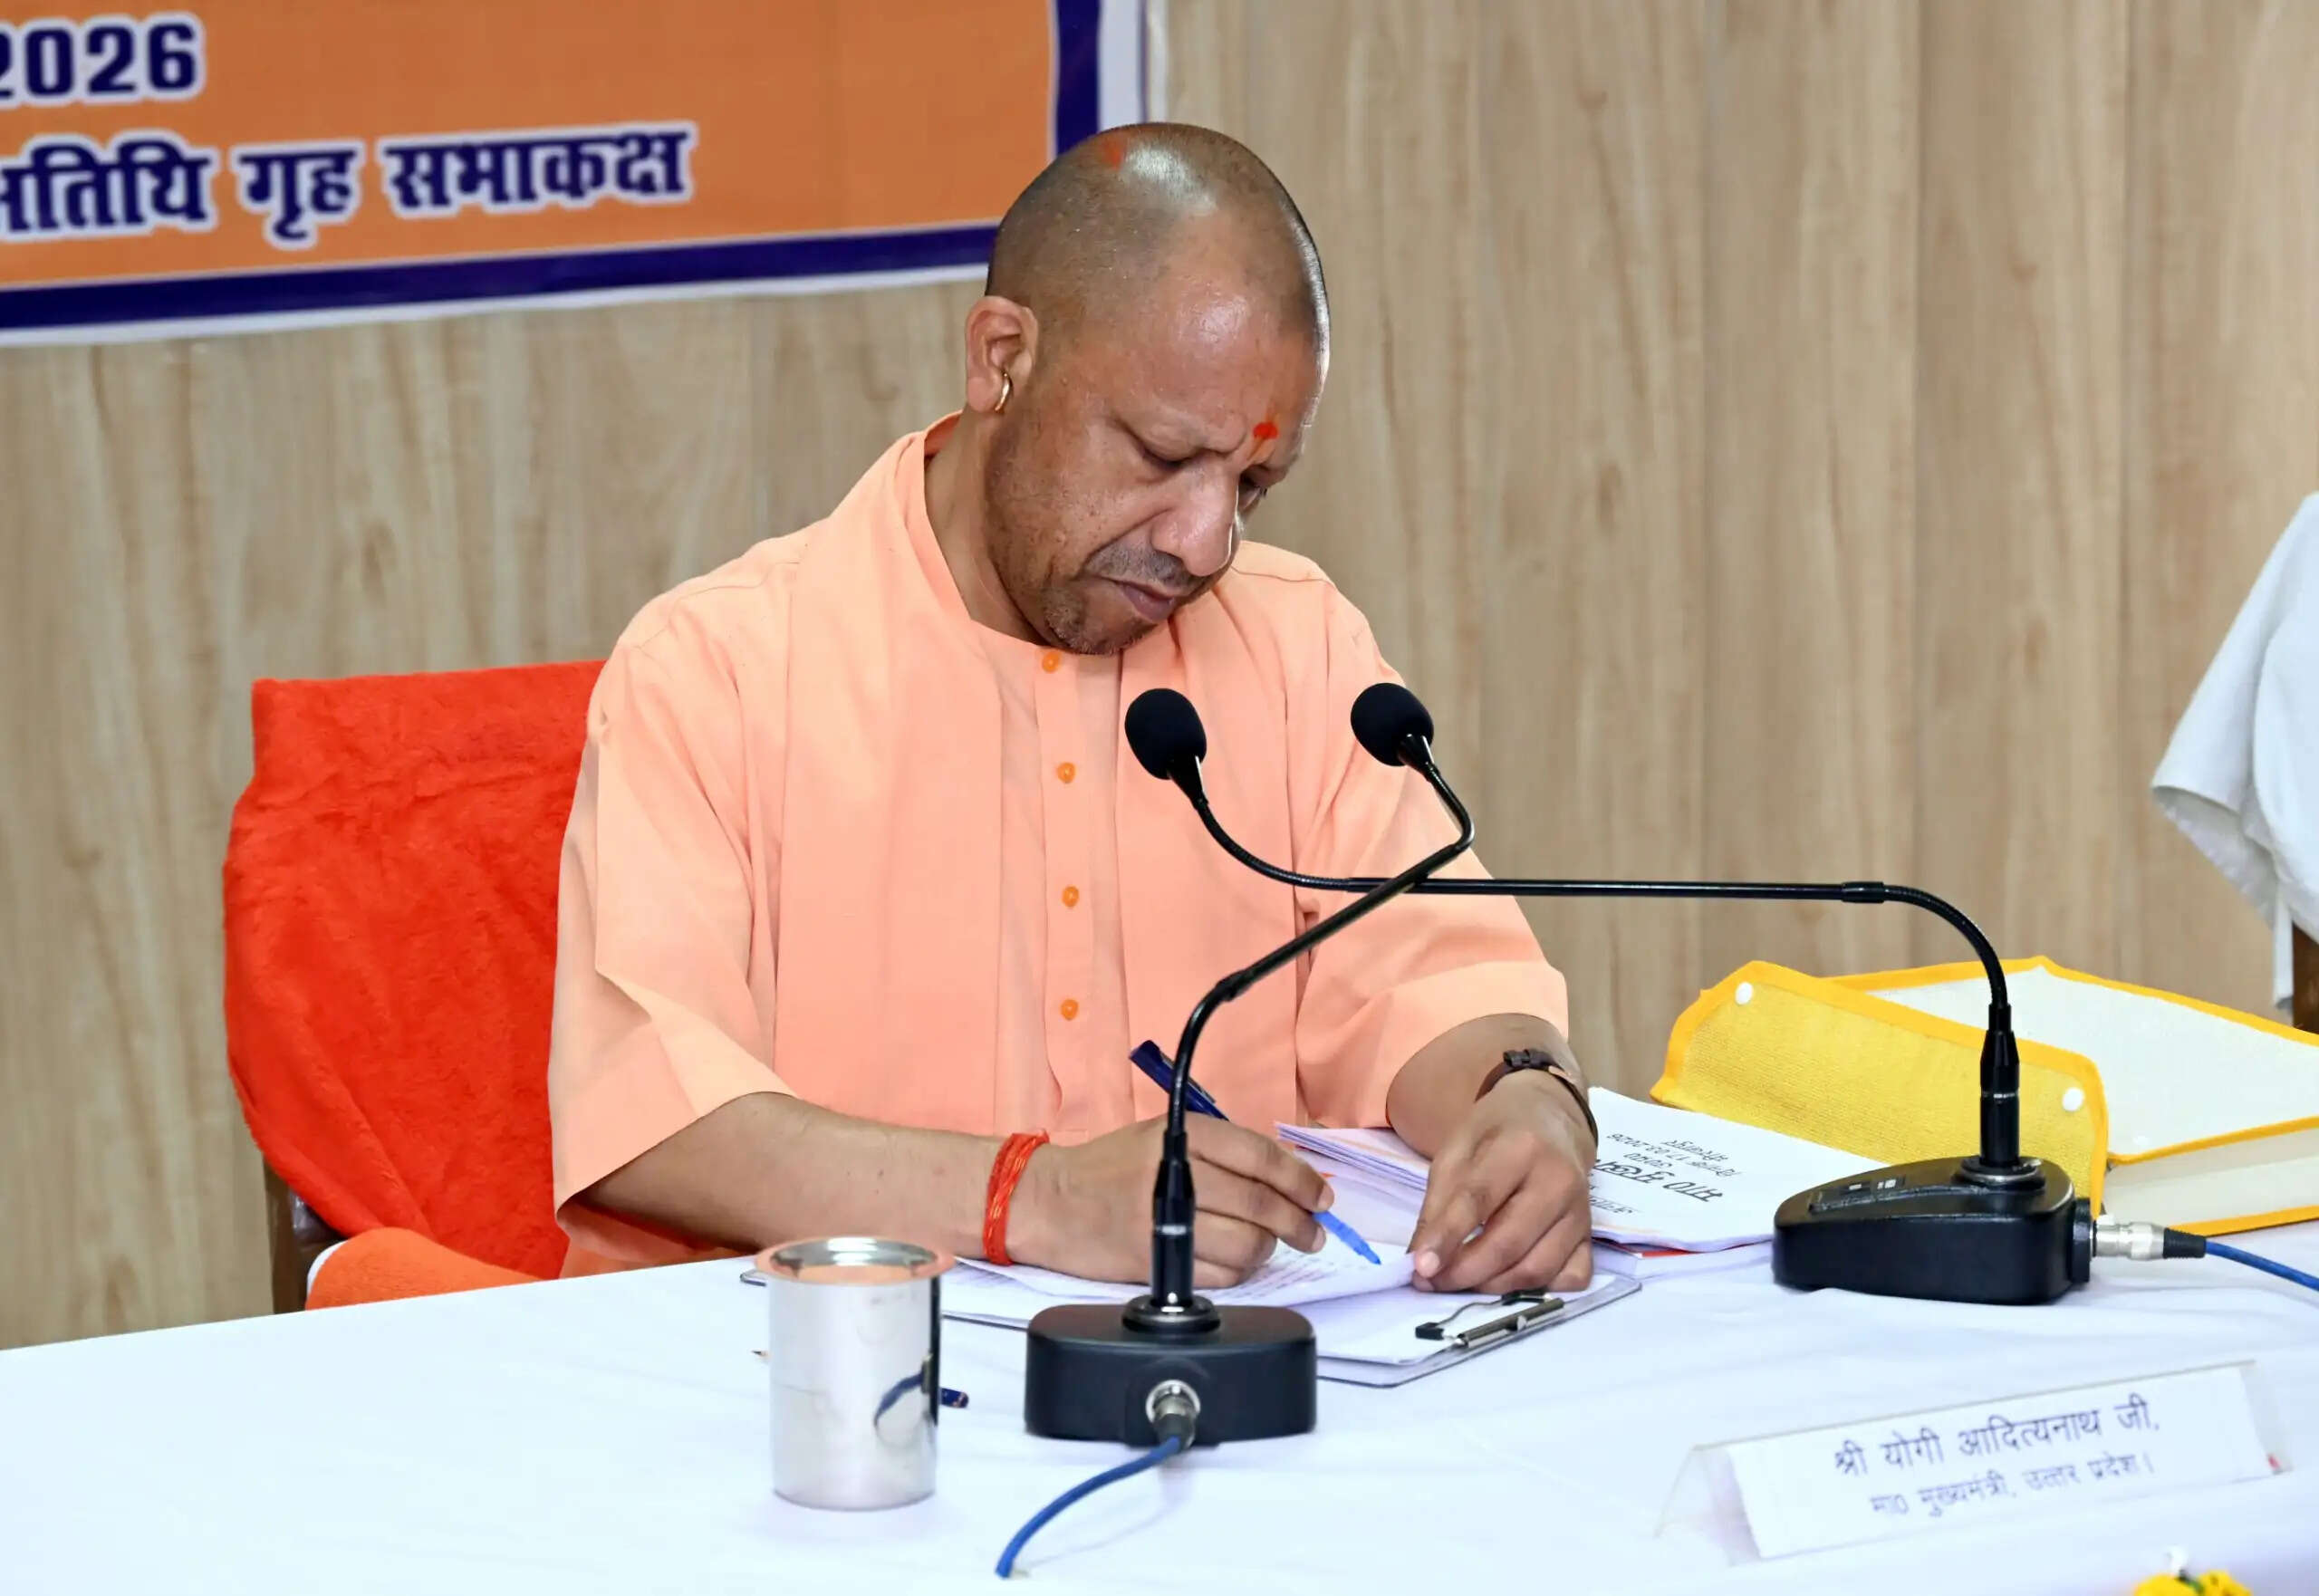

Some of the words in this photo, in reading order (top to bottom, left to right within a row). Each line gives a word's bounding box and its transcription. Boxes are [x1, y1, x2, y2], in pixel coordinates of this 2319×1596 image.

[238, 150, 357, 241] गृह
[383, 131, 689, 209] सभाकक्ष
[1593, 1159, 1676, 1184] मुख्य
[1834, 1439, 1868, 1477] श्री
[1881, 1427, 1945, 1470] योगी
[1958, 1414, 2102, 1458] आदित्यनाथ
